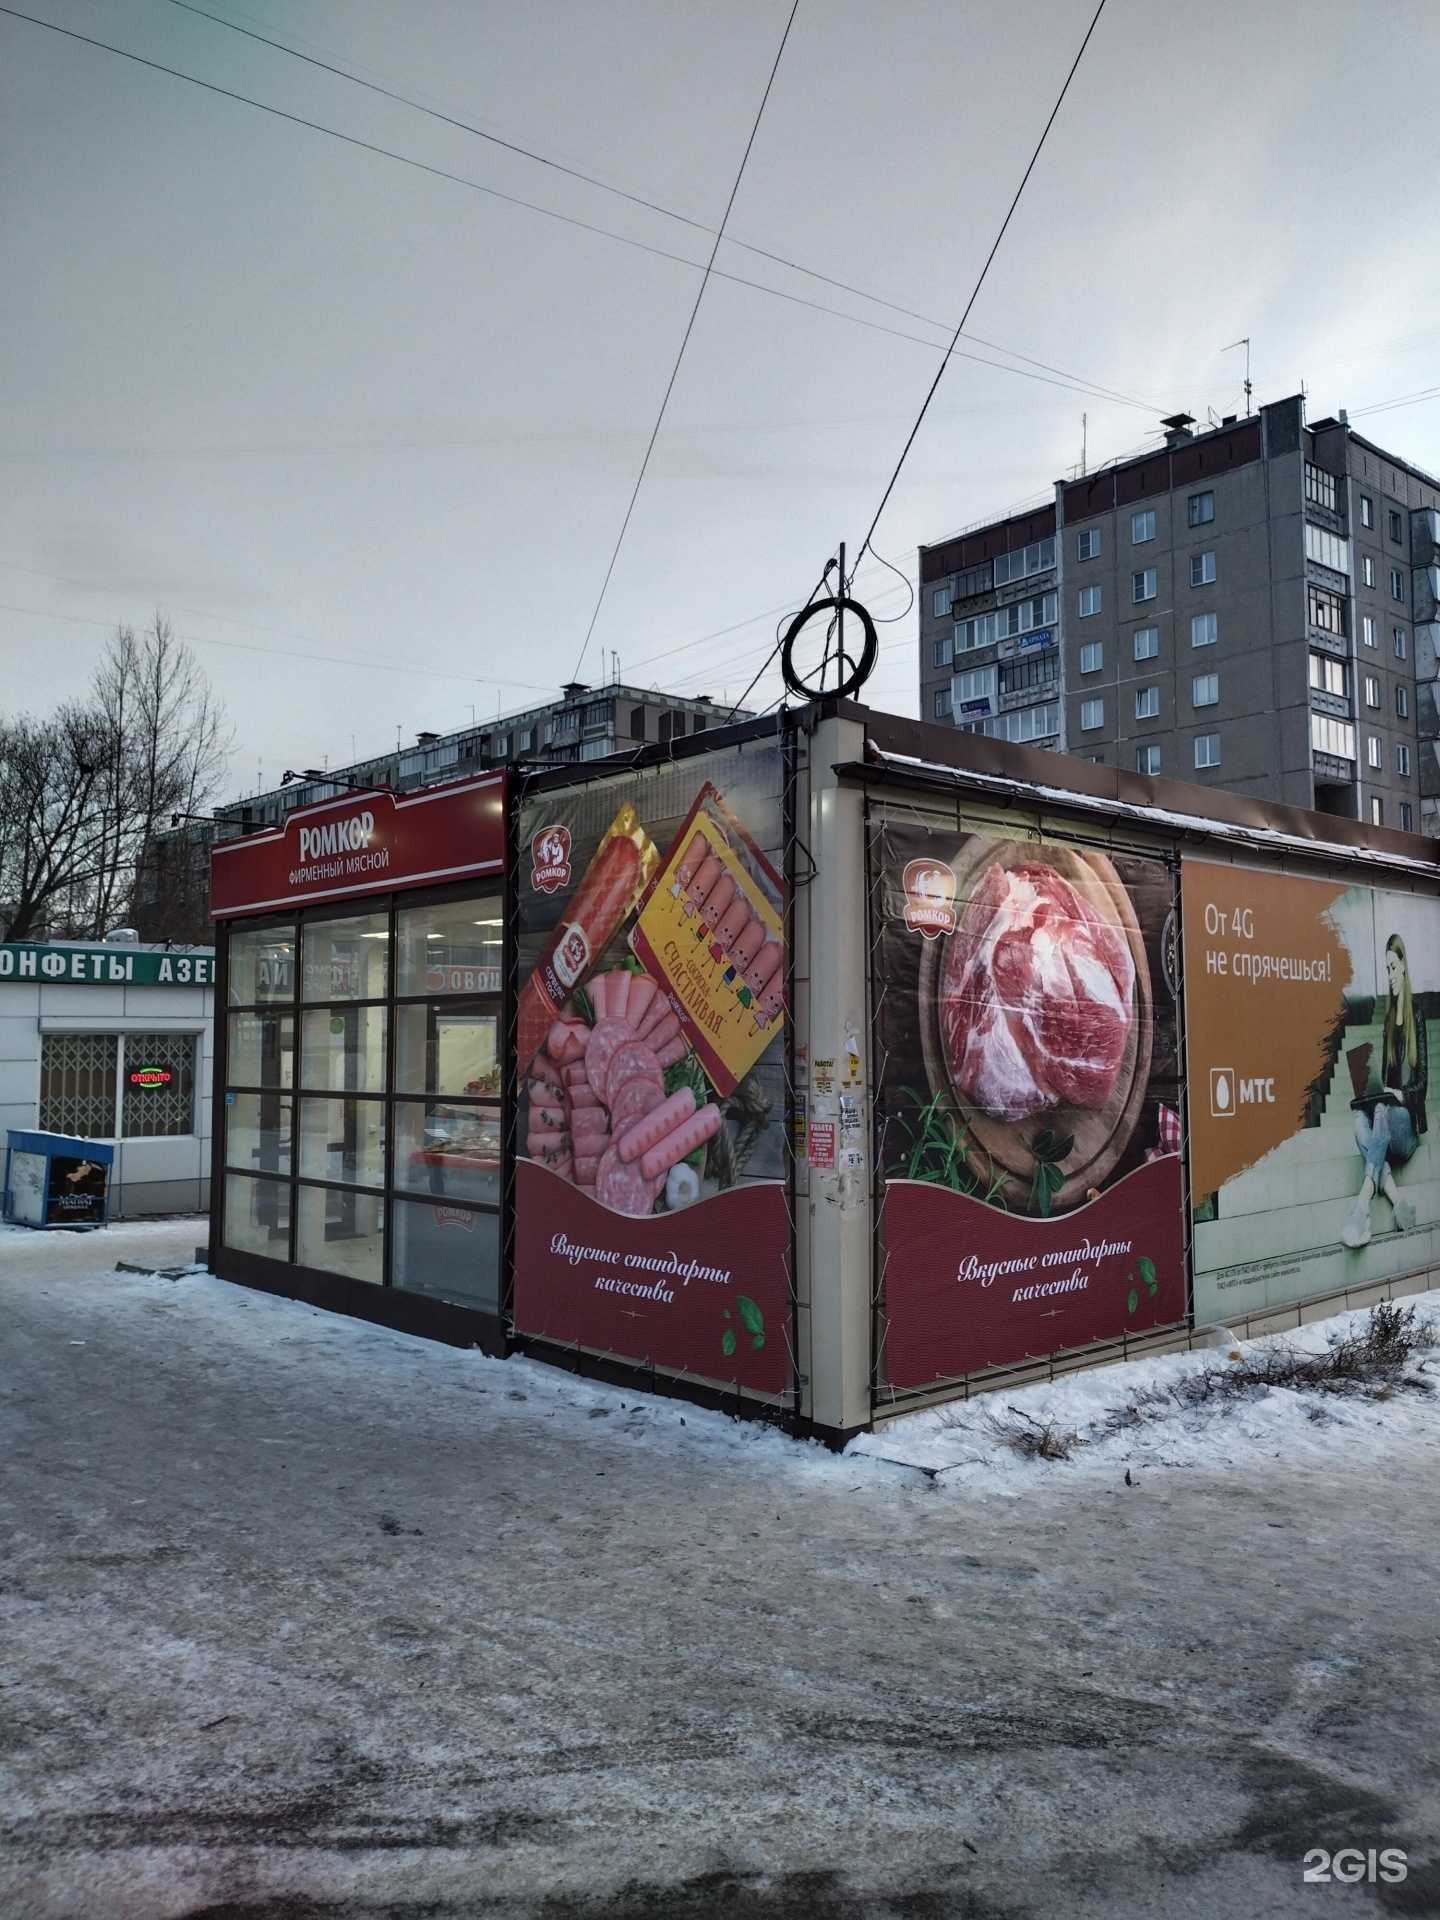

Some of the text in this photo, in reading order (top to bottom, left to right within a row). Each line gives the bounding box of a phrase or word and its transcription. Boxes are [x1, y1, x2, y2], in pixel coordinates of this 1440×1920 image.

[299, 811, 374, 862] РОМКОР
[289, 848, 389, 885] ФИРМЕННЫЙ МЯСНОЙ
[536, 867, 567, 883] РОМКОР
[911, 909, 951, 925] РОМКОР
[1205, 903, 1254, 939] От 4G
[158, 957, 215, 983] АЗЕ
[1206, 950, 1332, 984] не спрячешься!
[664, 940, 724, 1034] СЧАСТЛИВАЯ
[131, 1072, 171, 1082] ОТКРЫТО
[1239, 1078, 1275, 1104] МТС
[550, 1232, 732, 1286] Вкусные стандарты
[957, 1238, 1132, 1288] Вкусные стандарты
[594, 1277, 675, 1304] качества
[1012, 1267, 1089, 1303] качества
